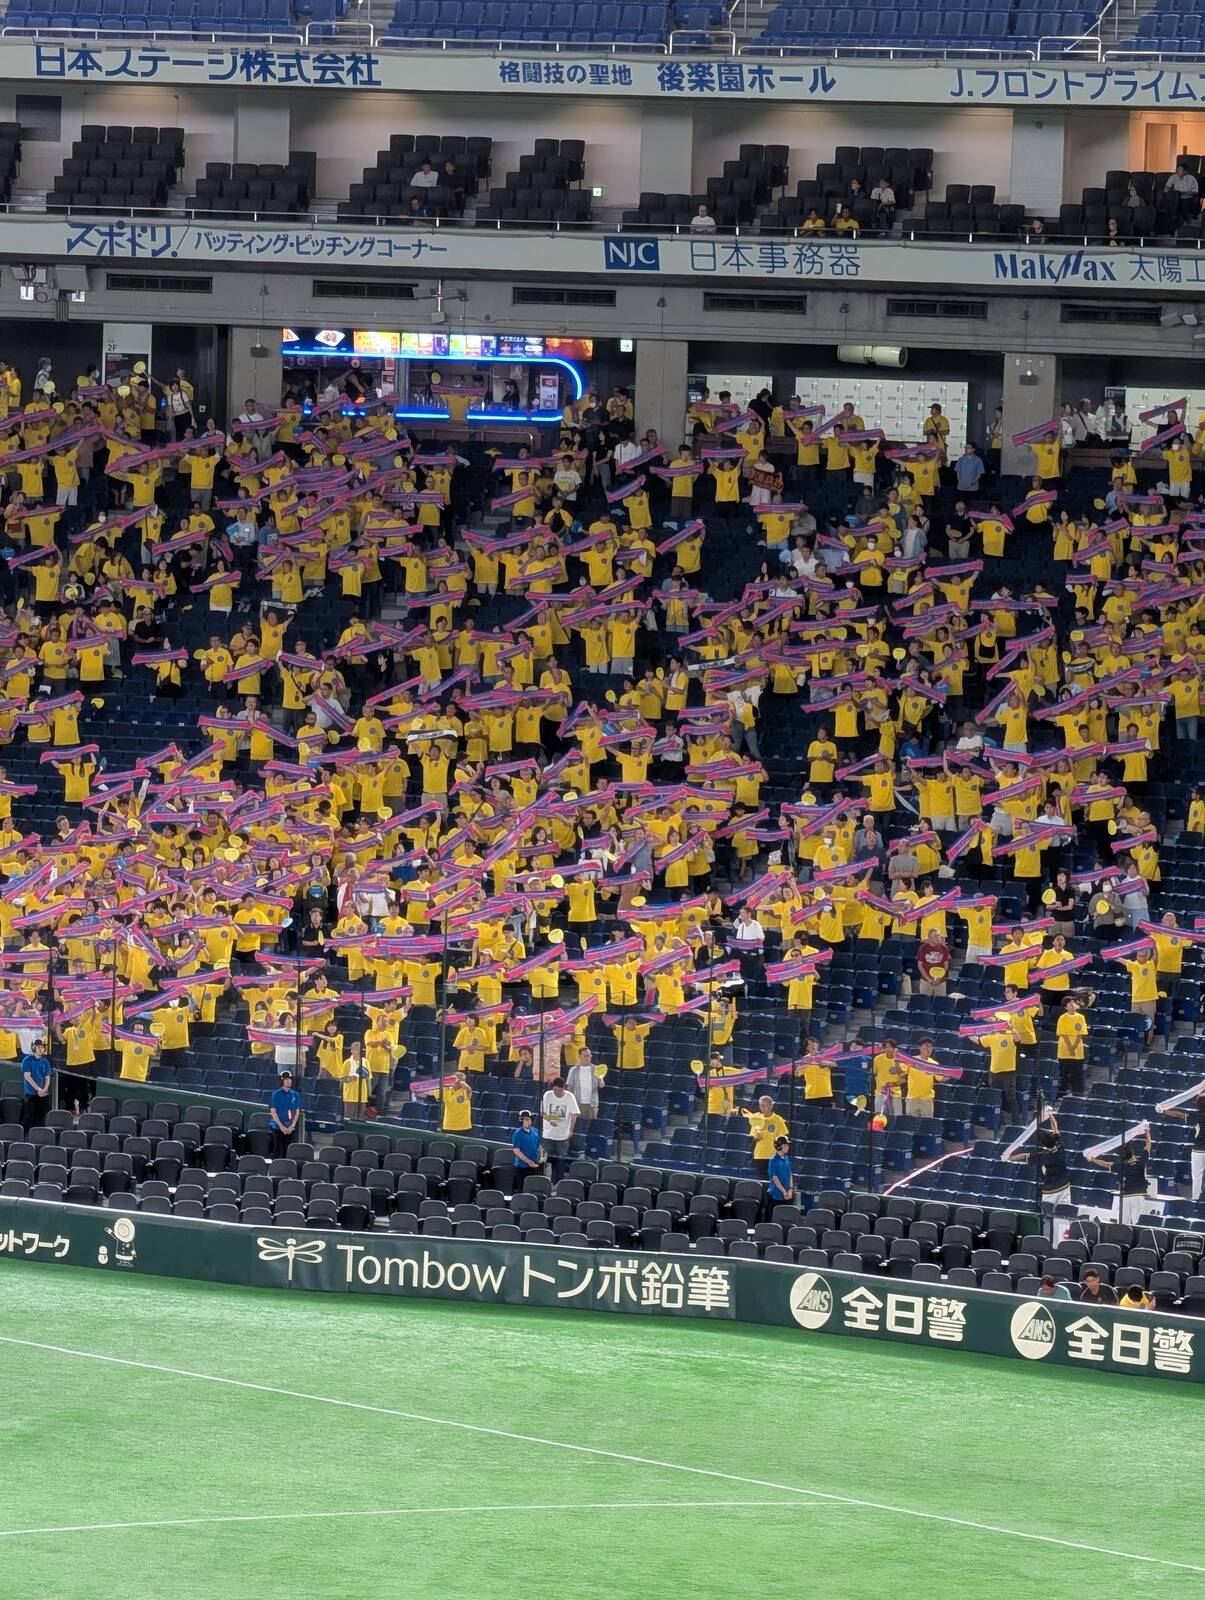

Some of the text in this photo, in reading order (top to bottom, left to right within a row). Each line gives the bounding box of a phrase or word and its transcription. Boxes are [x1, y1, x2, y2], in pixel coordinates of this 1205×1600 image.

[36, 47, 382, 86] 日本ステージ株式会社
[499, 61, 836, 93] 格闘技の聖地 後楽園ホール
[609, 242, 655, 267] NJC
[690, 240, 861, 276] 日本事務器
[337, 1245, 507, 1294] Tombow
[522, 1255, 731, 1311] トンボ鉛筆
[799, 1289, 831, 1312] ANS
[841, 1286, 968, 1342] 全日警
[1019, 1320, 1053, 1343] ANS
[1065, 1315, 1195, 1374] 全日警
